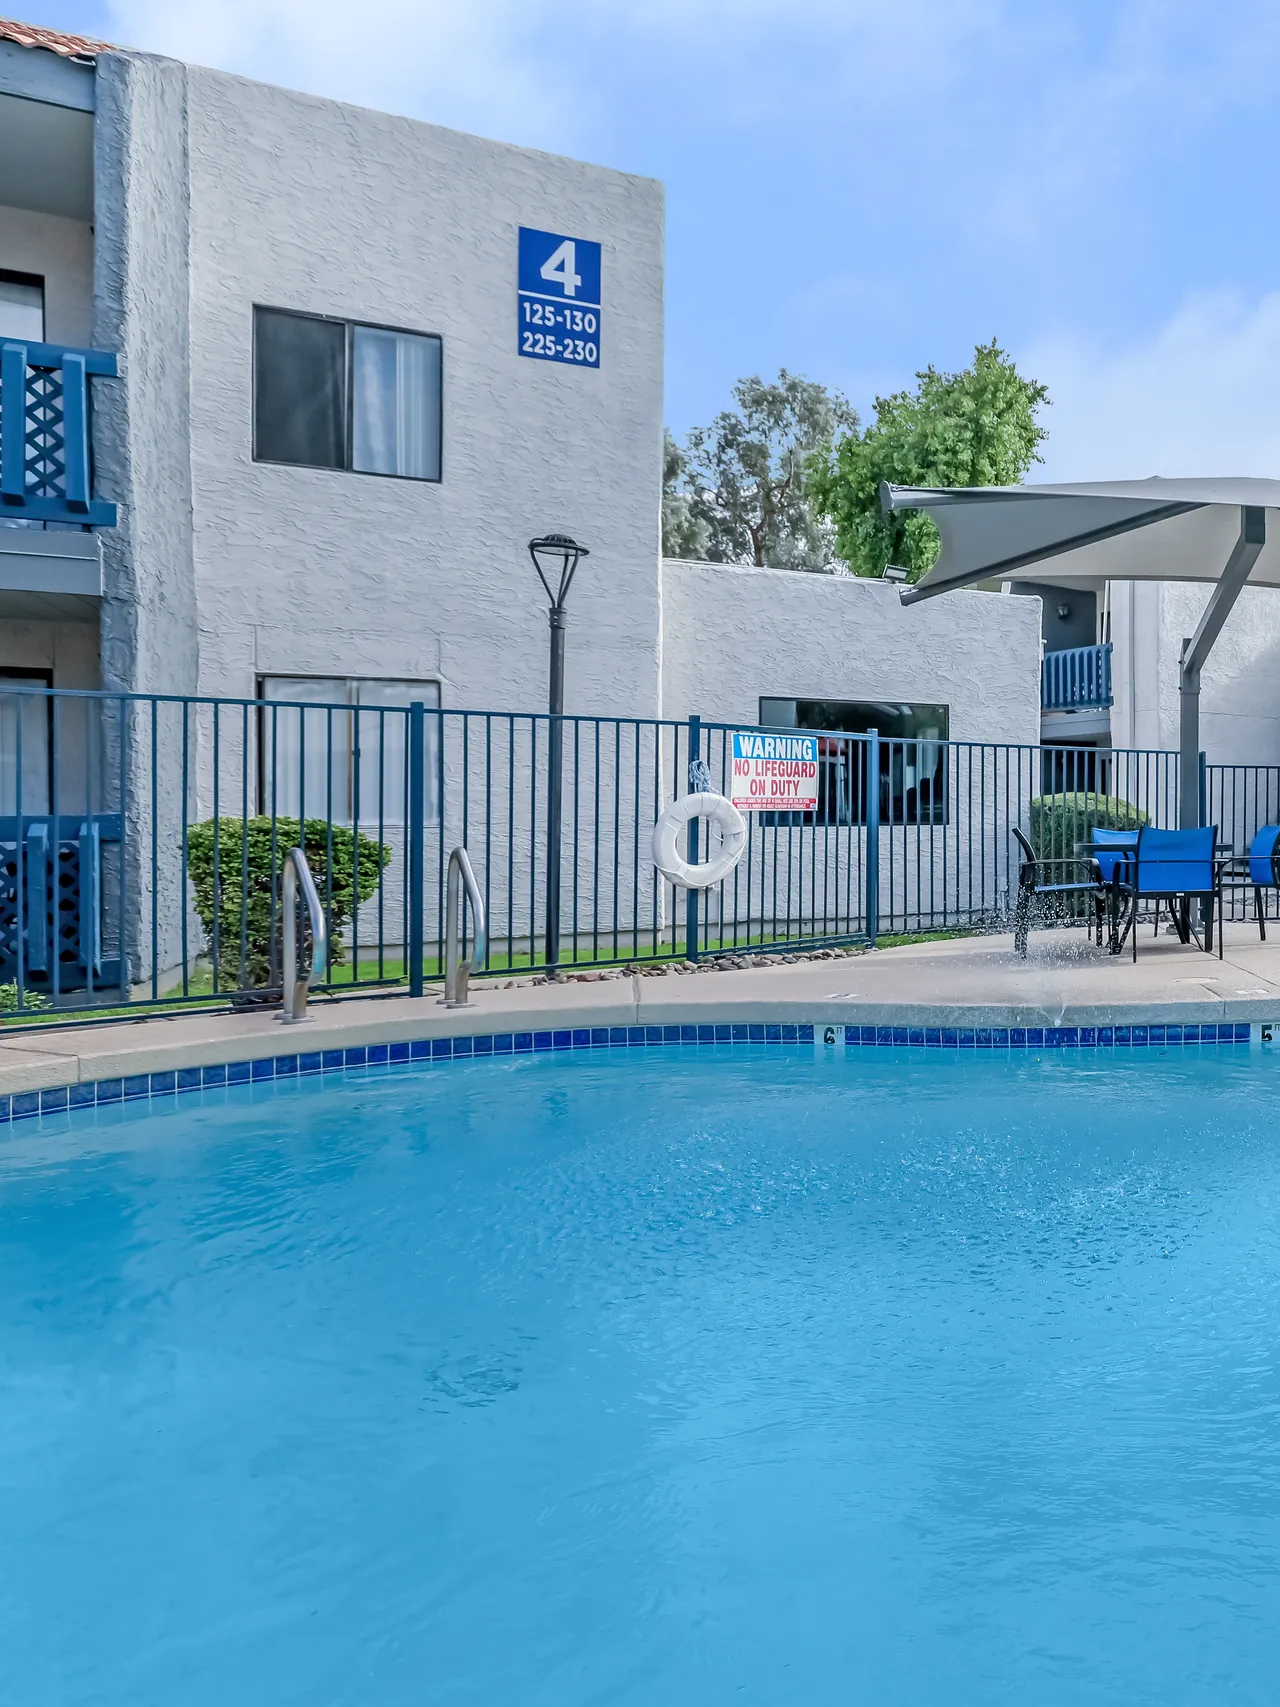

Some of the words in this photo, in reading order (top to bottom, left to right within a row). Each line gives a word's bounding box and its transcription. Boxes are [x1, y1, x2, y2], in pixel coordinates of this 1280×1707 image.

[540, 240, 582, 296] 4
[523, 302, 596, 334] 125-130
[522, 331, 597, 362] 225-230
[738, 735, 813, 761] WARNING
[734, 759, 750, 776] NO
[755, 760, 816, 778] LIFEGUARD
[750, 778, 766, 796] ON
[771, 779, 800, 796] DUTY
[823, 1026, 836, 1044] 6
[1261, 1024, 1273, 1041] 5
[1274, 1023, 1280, 1031] FT
